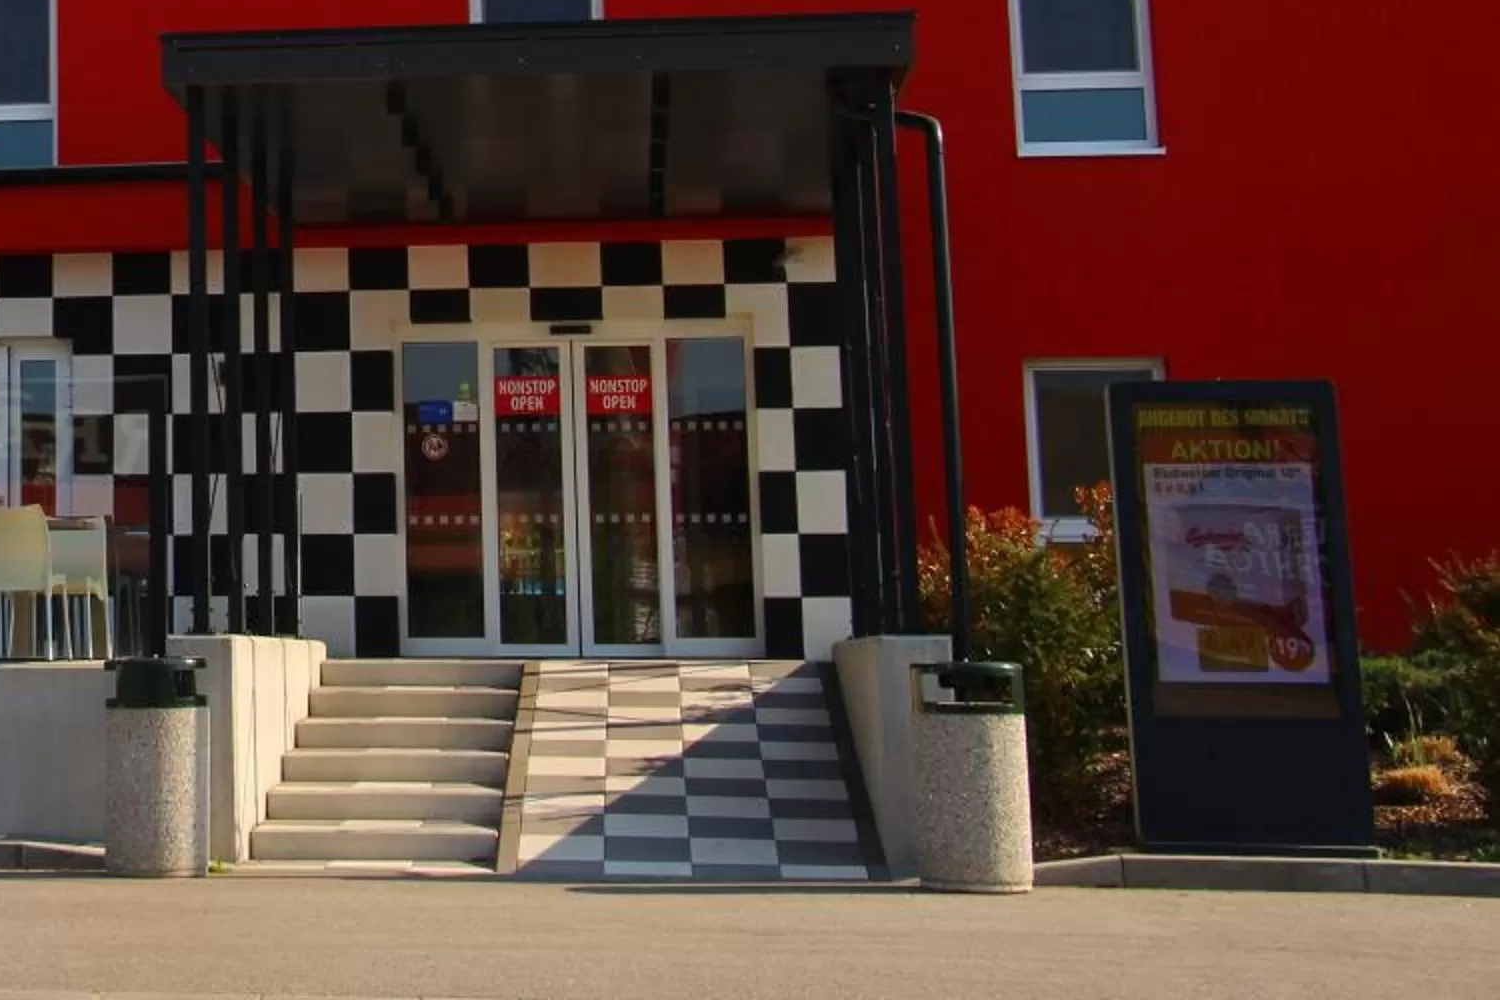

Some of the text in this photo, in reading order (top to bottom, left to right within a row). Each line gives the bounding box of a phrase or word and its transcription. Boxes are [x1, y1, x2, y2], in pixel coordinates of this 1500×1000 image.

[498, 379, 556, 394] NONSTOP
[589, 378, 648, 393] NONSTOP
[510, 395, 545, 411] OPEN
[602, 394, 637, 410] OPEN
[1171, 439, 1280, 461] AKTION!
